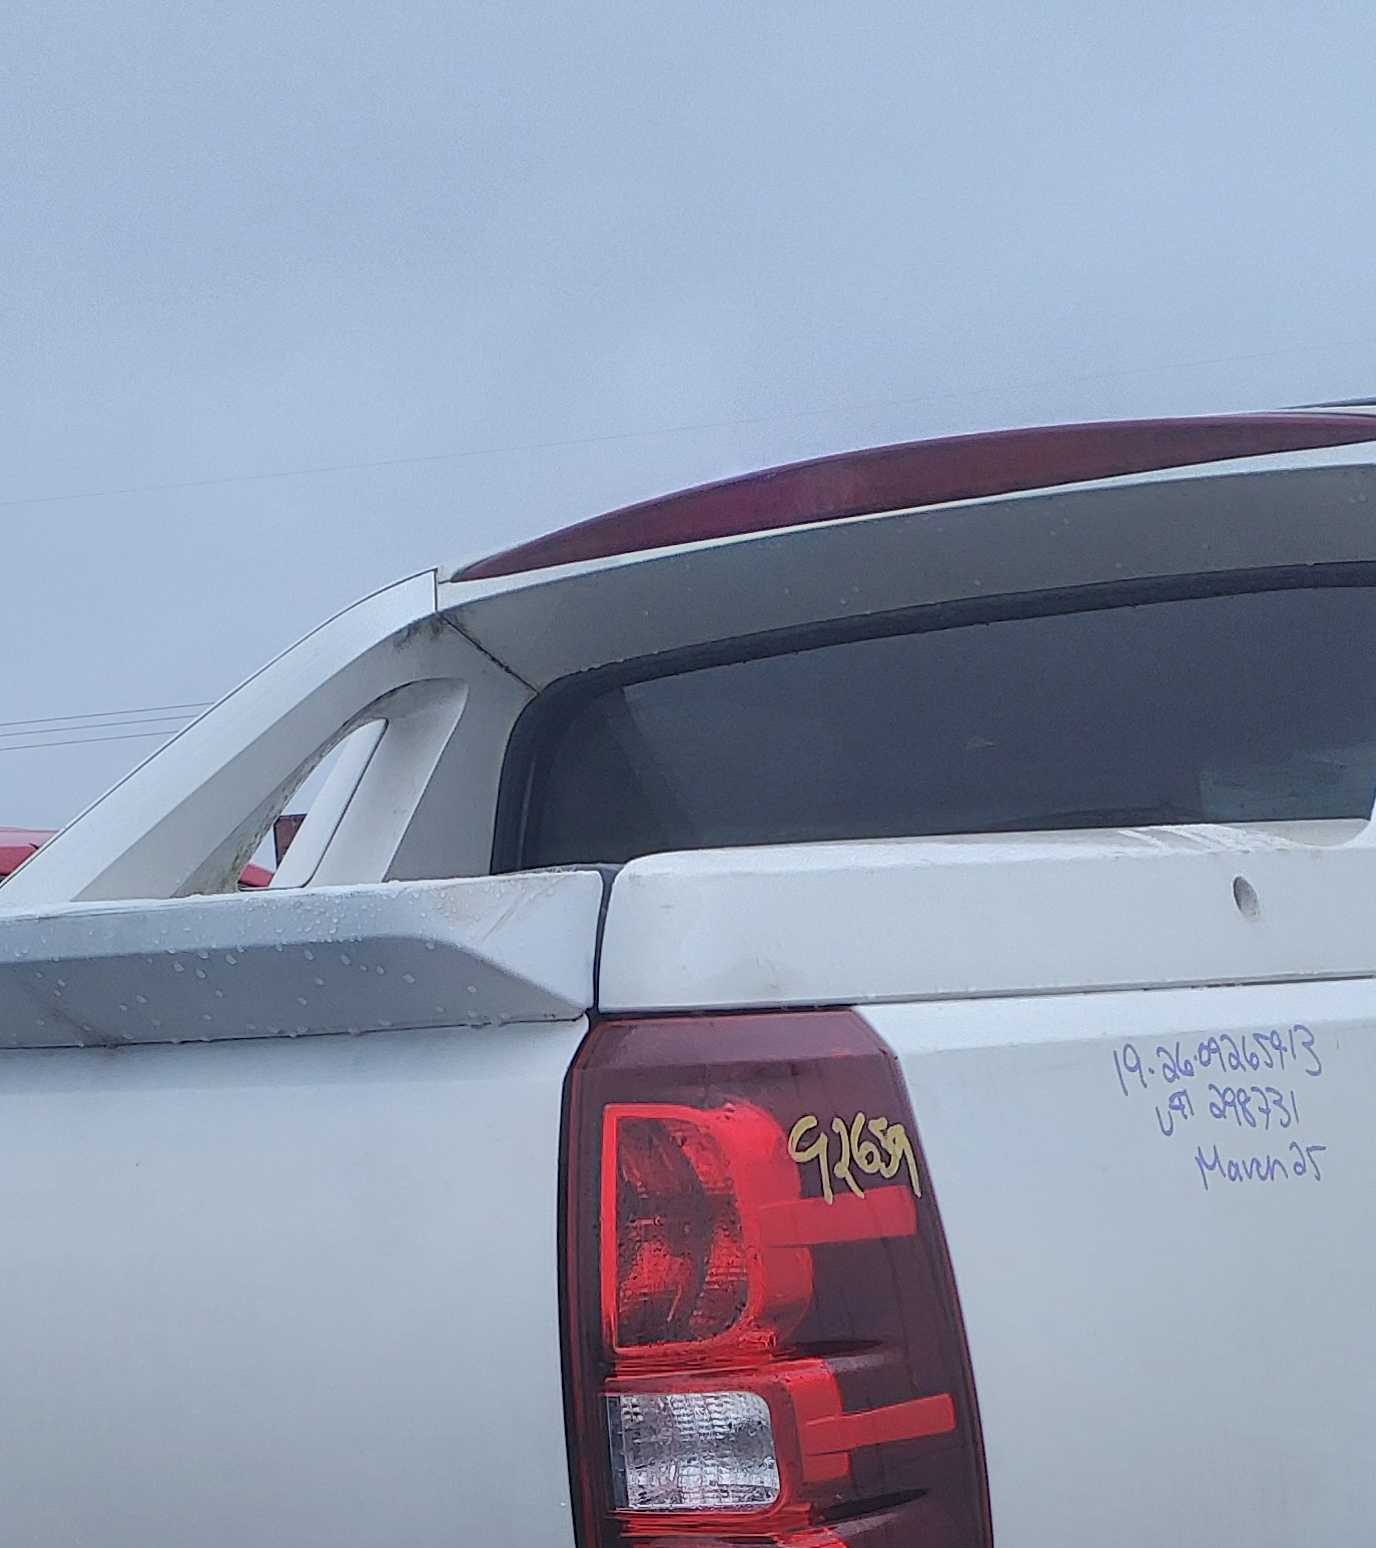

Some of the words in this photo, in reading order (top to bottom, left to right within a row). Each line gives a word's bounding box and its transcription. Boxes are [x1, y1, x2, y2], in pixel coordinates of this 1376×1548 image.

[1208, 1083, 1300, 1131] 298731
[788, 1111, 922, 1205] 92659
[1287, 1141, 1327, 1182] 25
